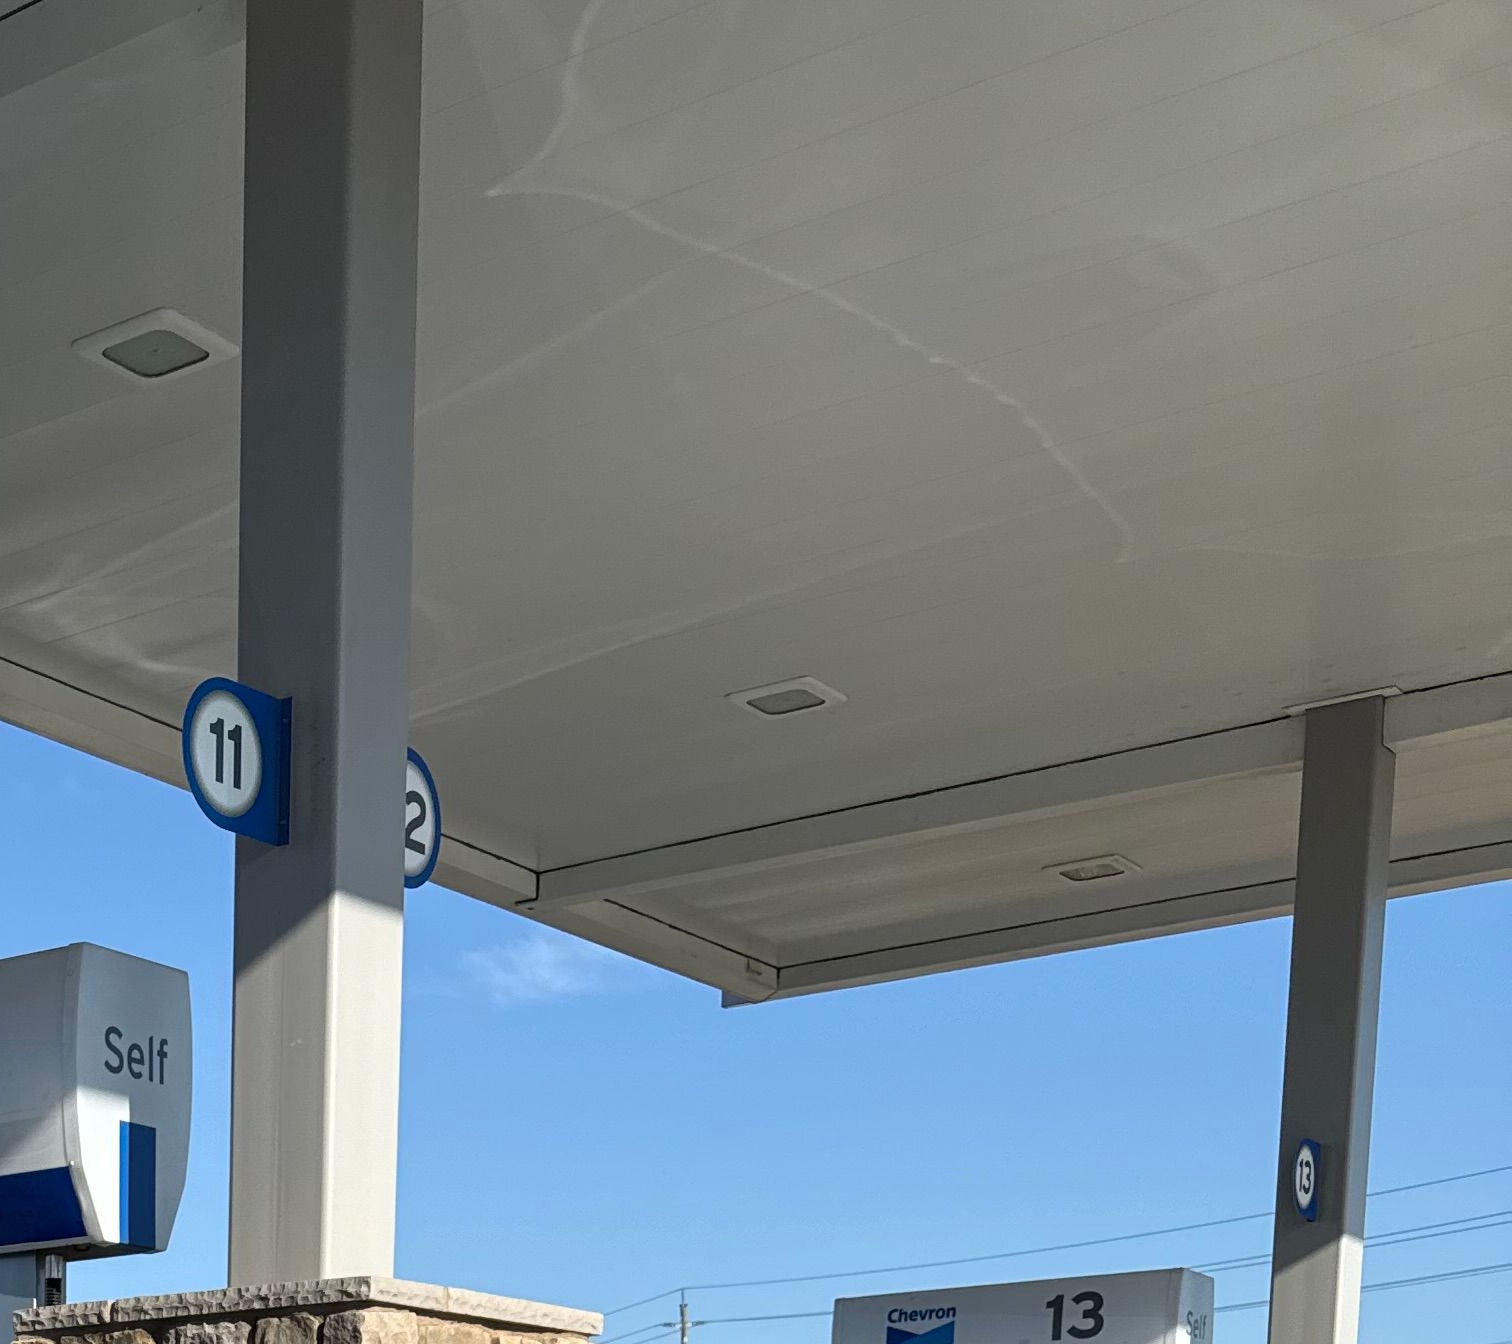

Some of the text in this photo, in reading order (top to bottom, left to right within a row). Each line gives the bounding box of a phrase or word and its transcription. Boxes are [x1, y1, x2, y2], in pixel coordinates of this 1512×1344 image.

[209, 717, 243, 790] 11
[405, 790, 427, 856] 2
[103, 1025, 169, 1085] Self
[1299, 1158, 1311, 1195] 13
[887, 1306, 956, 1324] Chevron
[1045, 1291, 1105, 1342] 13
[1186, 1310, 1207, 1340] Self
